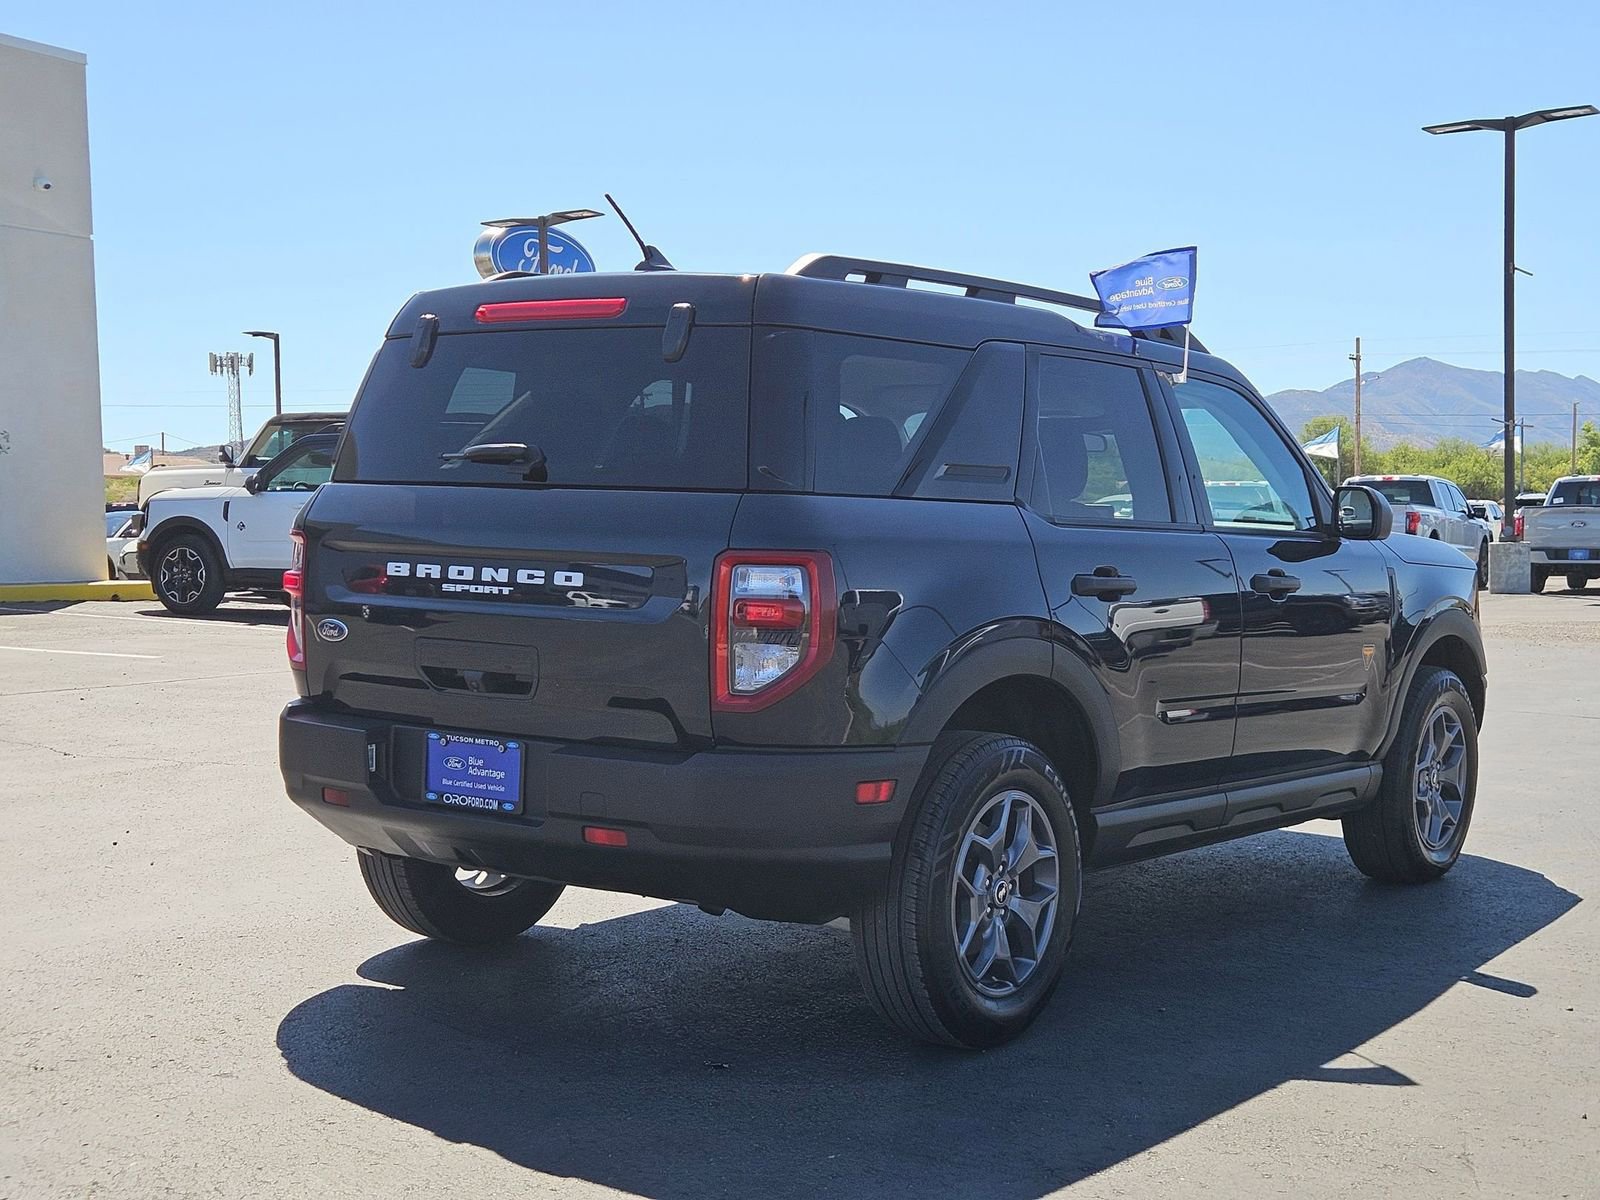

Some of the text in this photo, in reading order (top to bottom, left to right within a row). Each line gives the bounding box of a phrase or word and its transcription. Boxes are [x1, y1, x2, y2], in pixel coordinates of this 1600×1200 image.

[386, 561, 584, 587] BRONCO
[442, 583, 514, 595] SPORT
[446, 734, 474, 744] TUCSON
[474, 738, 499, 747] METRO
[468, 756, 484, 767] Blue
[467, 766, 506, 780] Advantage
[442, 778, 505, 792] Blue Certified Used Vehicle
[443, 793, 499, 811] OROFORD.COM
